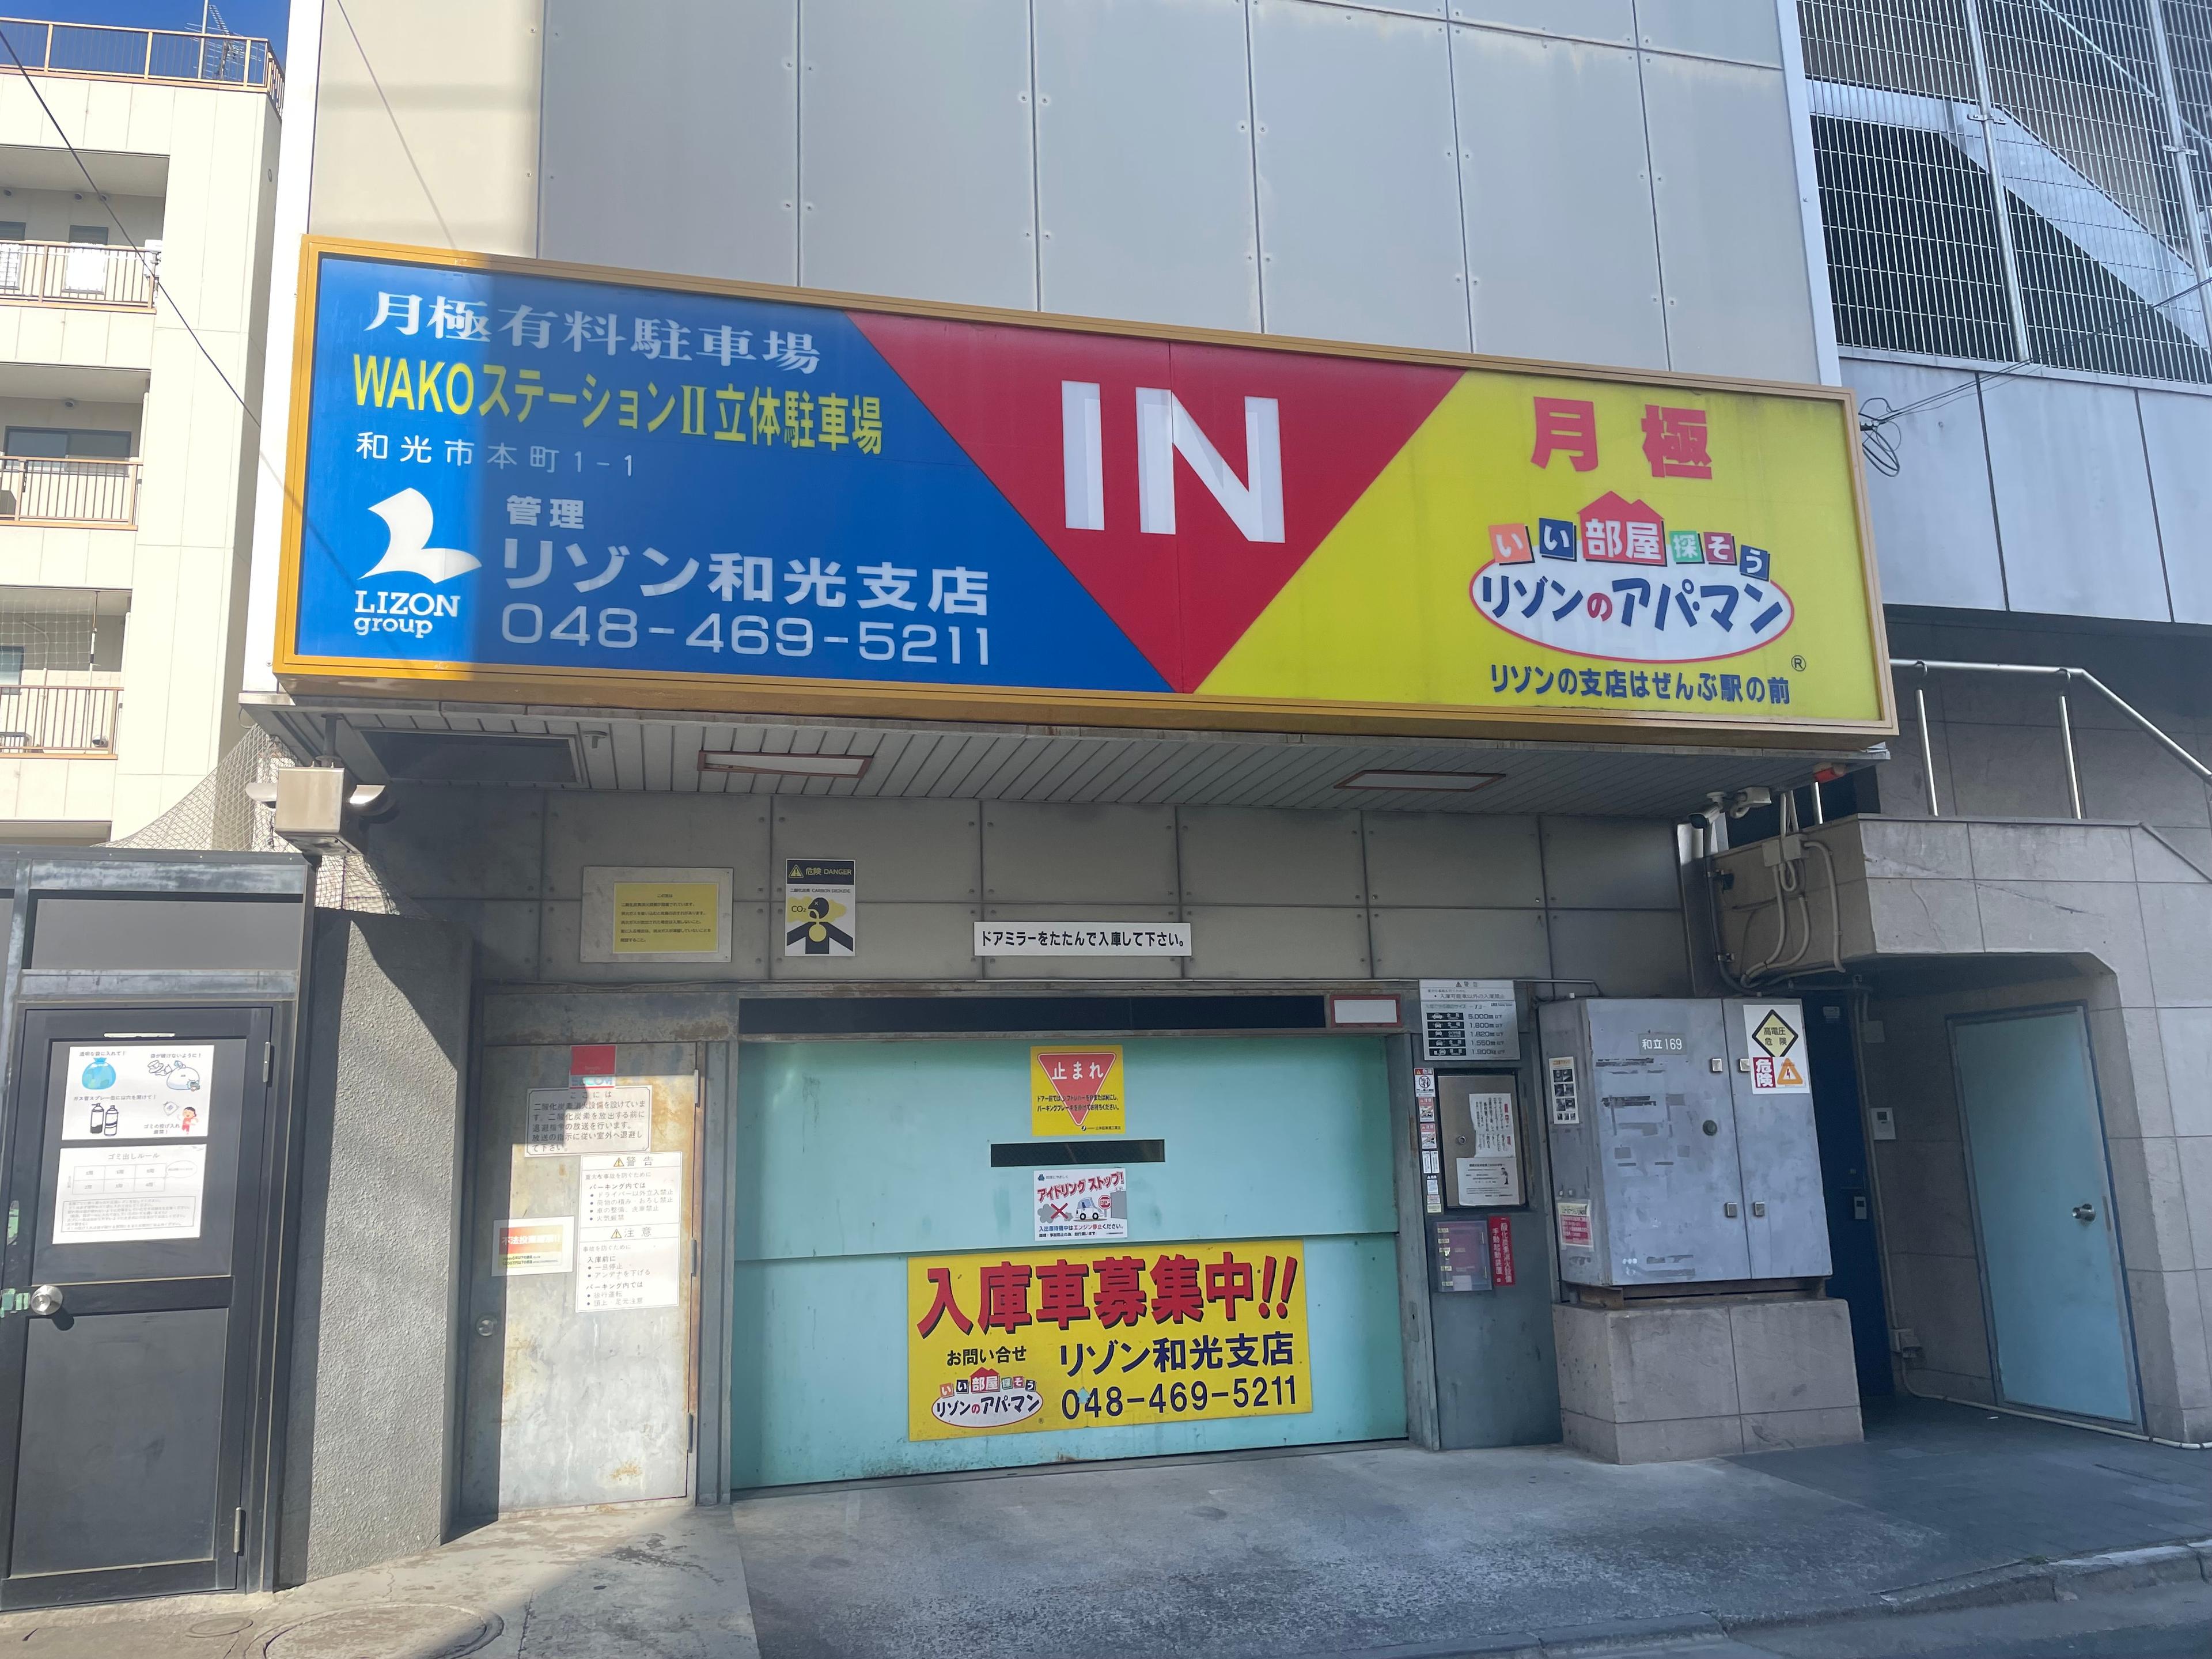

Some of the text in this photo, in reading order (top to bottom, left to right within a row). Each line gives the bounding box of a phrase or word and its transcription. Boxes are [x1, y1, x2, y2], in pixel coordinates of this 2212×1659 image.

[364, 291, 820, 374] 月極有料駐車場
[1531, 396, 1712, 480] 月極
[356, 431, 634, 476] 和光市本町1-1
[1061, 380, 1285, 543] IN
[506, 495, 585, 529] 管理
[1495, 518, 1763, 574] いい部屋探そう
[504, 538, 988, 616] リゾン和光支店
[354, 590, 460, 617] LIZON
[354, 618, 433, 639] group
[502, 602, 988, 665] 048-469-5211
[1490, 664, 1790, 704] リゾンの支店はぜんぶ駅の前
[805, 867, 821, 875] 危険
[982, 930, 1184, 948] ドアミラーをたたんで入庫して下さい。
[1763, 1027, 1786, 1036] 高電圧
[1764, 1037, 1787, 1046] 危険
[1642, 1038, 1683, 1050] 和立169
[1051, 1060, 1104, 1080] 止まれ
[1756, 1058, 1774, 1088] 危険
[532, 1131, 643, 1142] 放送の指示に従い室外へ退避し
[626, 1156, 653, 1166] 警告
[585, 1172, 652, 1180] 重大な事故を防ぐために
[1037, 1171, 1125, 1203] アイドリング ストップ!
[624, 1227, 652, 1238] 注意
[582, 1244, 631, 1252] 事故を防ぐために
[594, 1269, 650, 1278] アンテナを下げる
[585, 1282, 643, 1290] パーキング内では
[916, 1252, 1298, 1340] 入庫車募集中!!
[946, 1346, 1028, 1367] お問い合せ
[1060, 1331, 1294, 1378] リゾン和光支店
[1062, 1375, 1297, 1421] 048-469-5211
